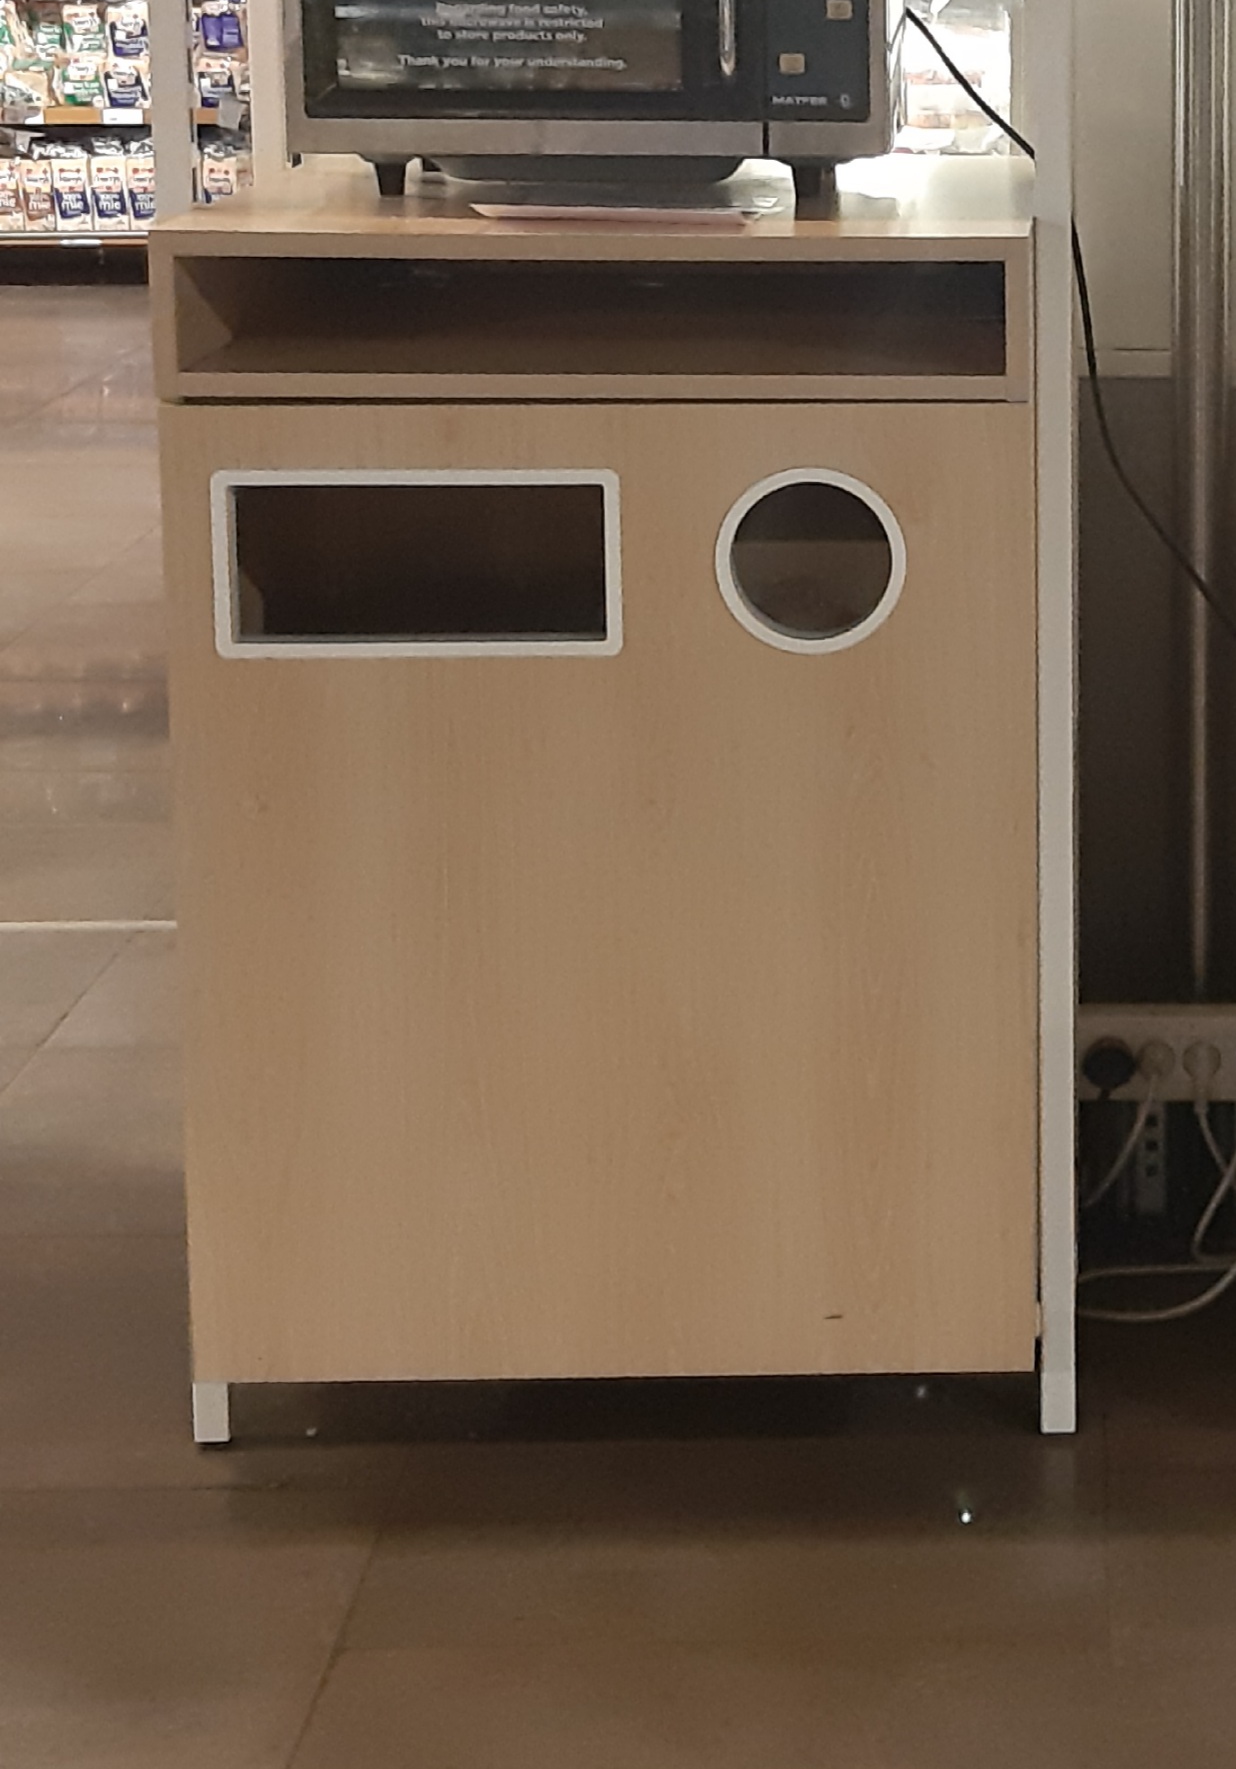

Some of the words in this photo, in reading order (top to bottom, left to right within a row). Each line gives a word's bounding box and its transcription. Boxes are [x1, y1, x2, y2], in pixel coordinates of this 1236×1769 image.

[539, 18, 604, 29] restricted
[437, 29, 452, 40] to
[492, 30, 552, 43] products
[398, 54, 438, 67] Thank
[441, 56, 468, 68] you
[470, 55, 491, 67] for
[493, 57, 524, 69] your
